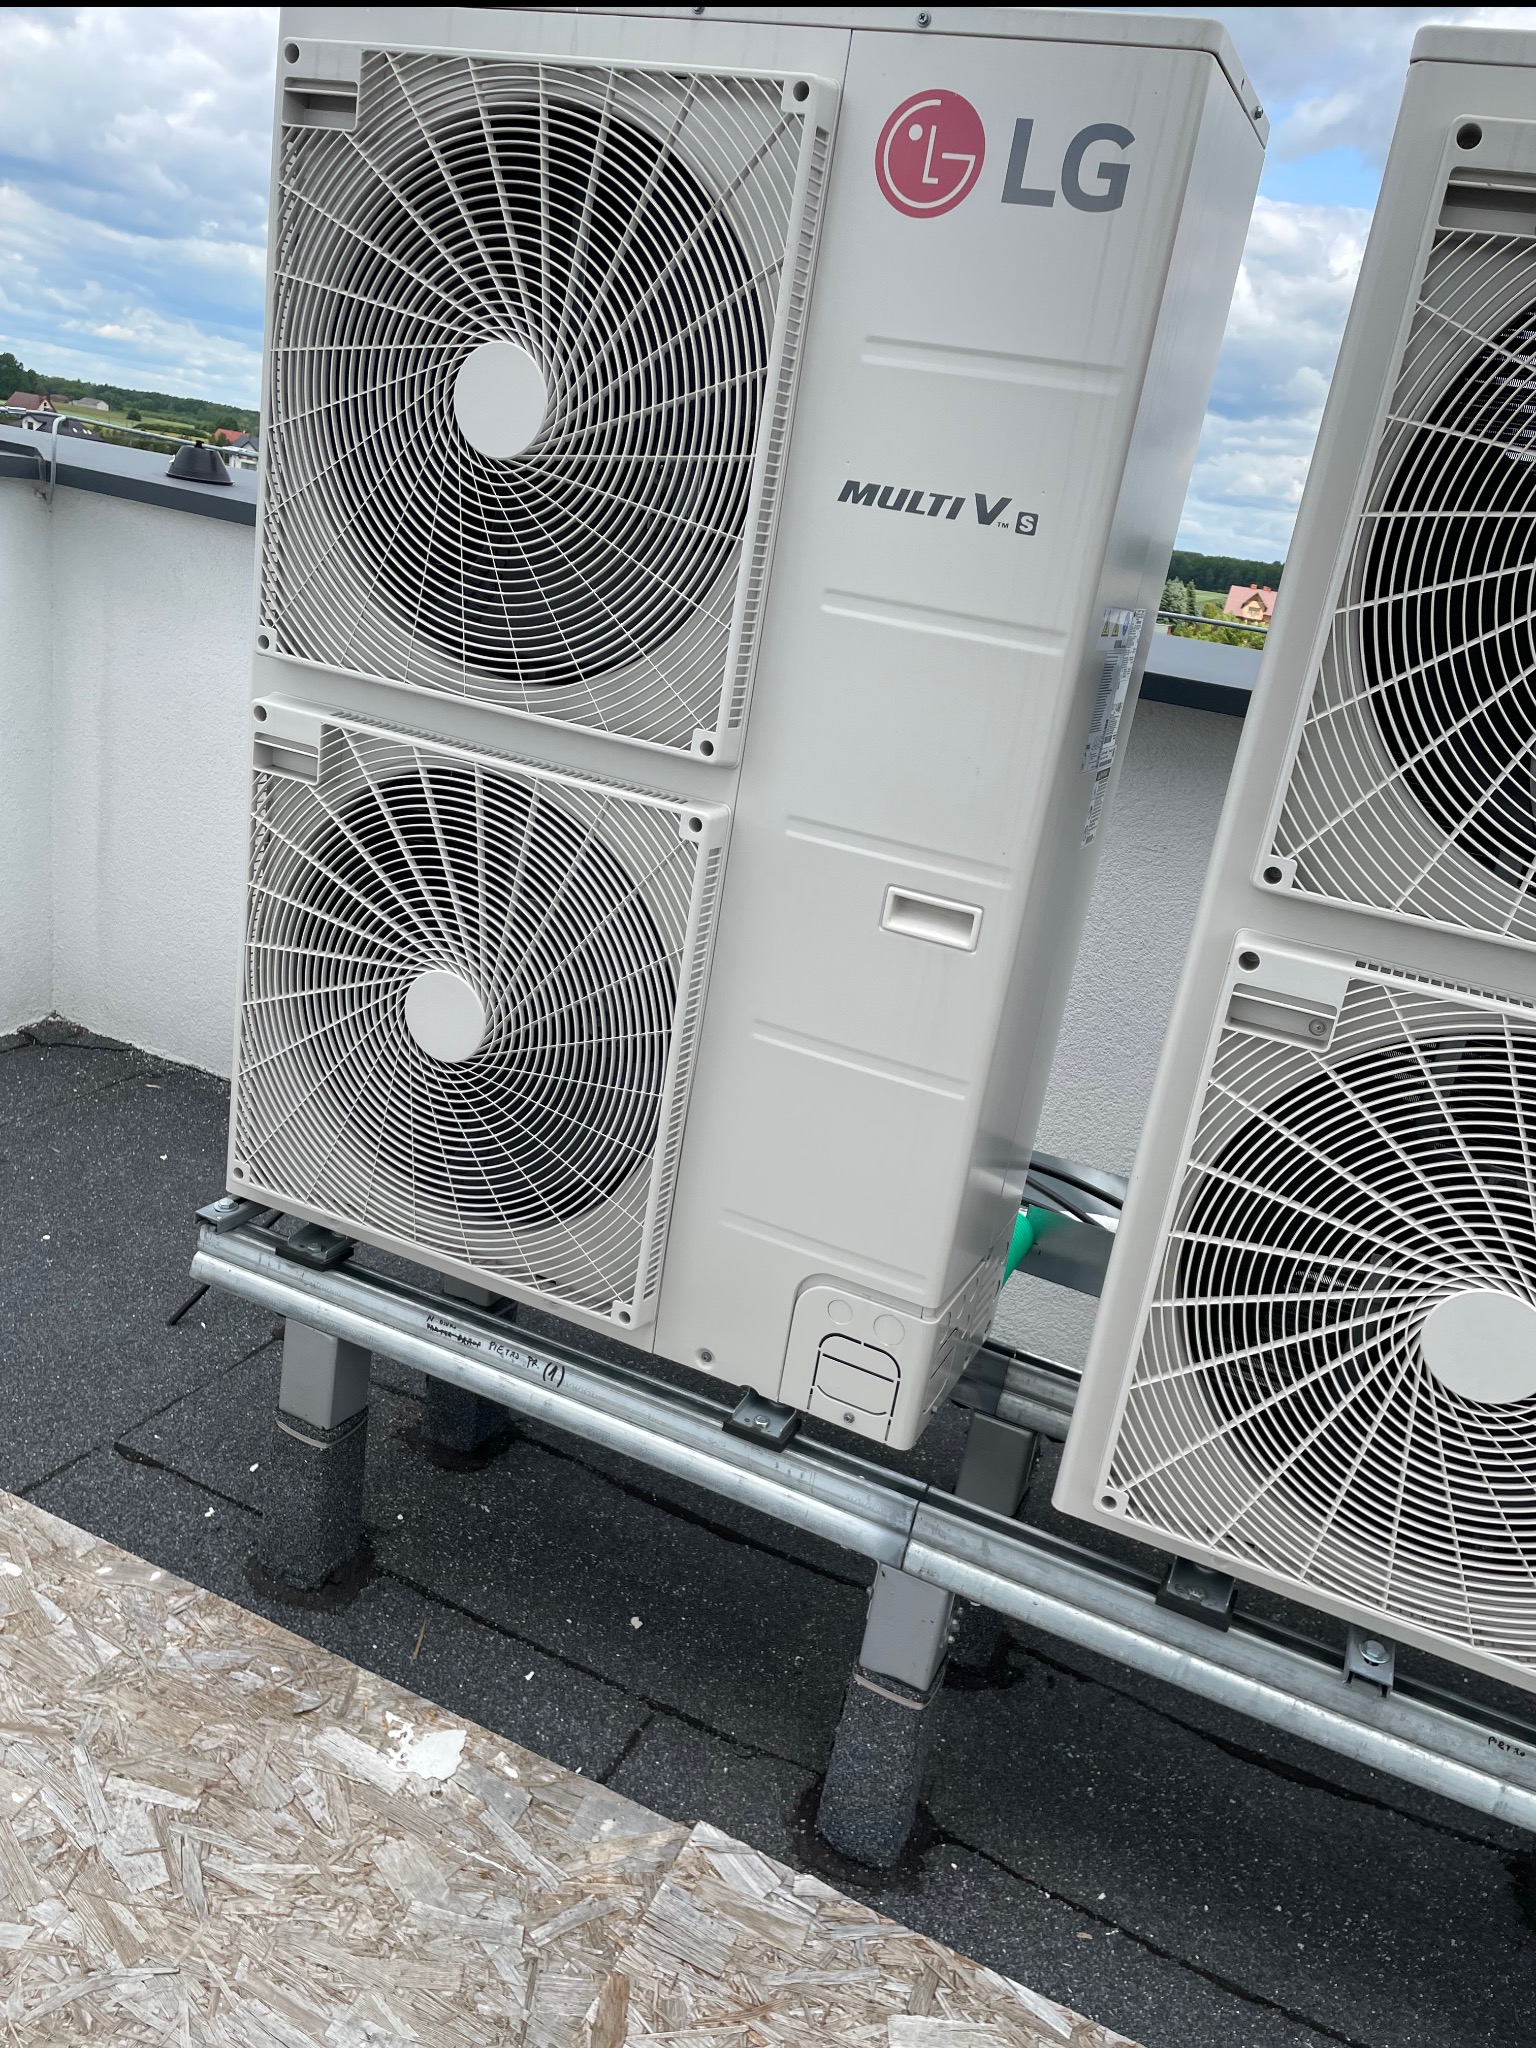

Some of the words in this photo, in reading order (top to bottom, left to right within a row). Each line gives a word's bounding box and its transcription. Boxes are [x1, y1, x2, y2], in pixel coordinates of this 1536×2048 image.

[1001, 117, 1136, 213] LG
[838, 480, 966, 520] MULTI
[1017, 513, 1037, 534] S
